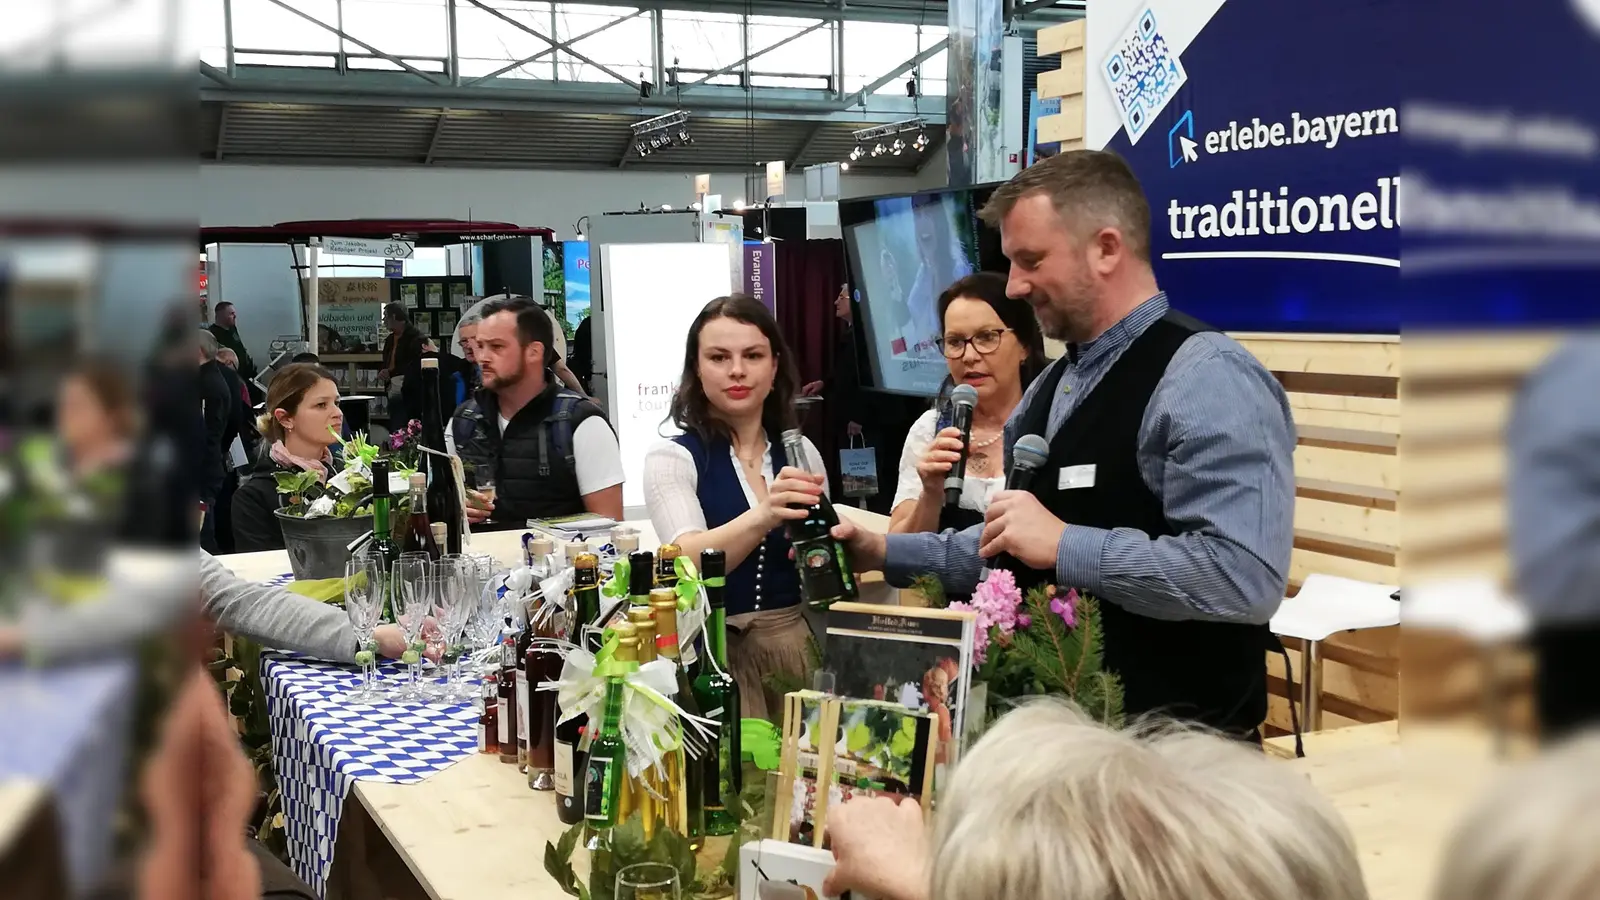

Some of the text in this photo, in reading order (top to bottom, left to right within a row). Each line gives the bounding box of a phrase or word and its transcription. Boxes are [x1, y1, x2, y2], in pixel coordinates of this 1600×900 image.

[1205, 107, 1398, 154] erlebe.bayern
[1167, 176, 1400, 240] traditionell
[751, 250, 764, 300] Evangelis
[357, 313, 374, 322] und
